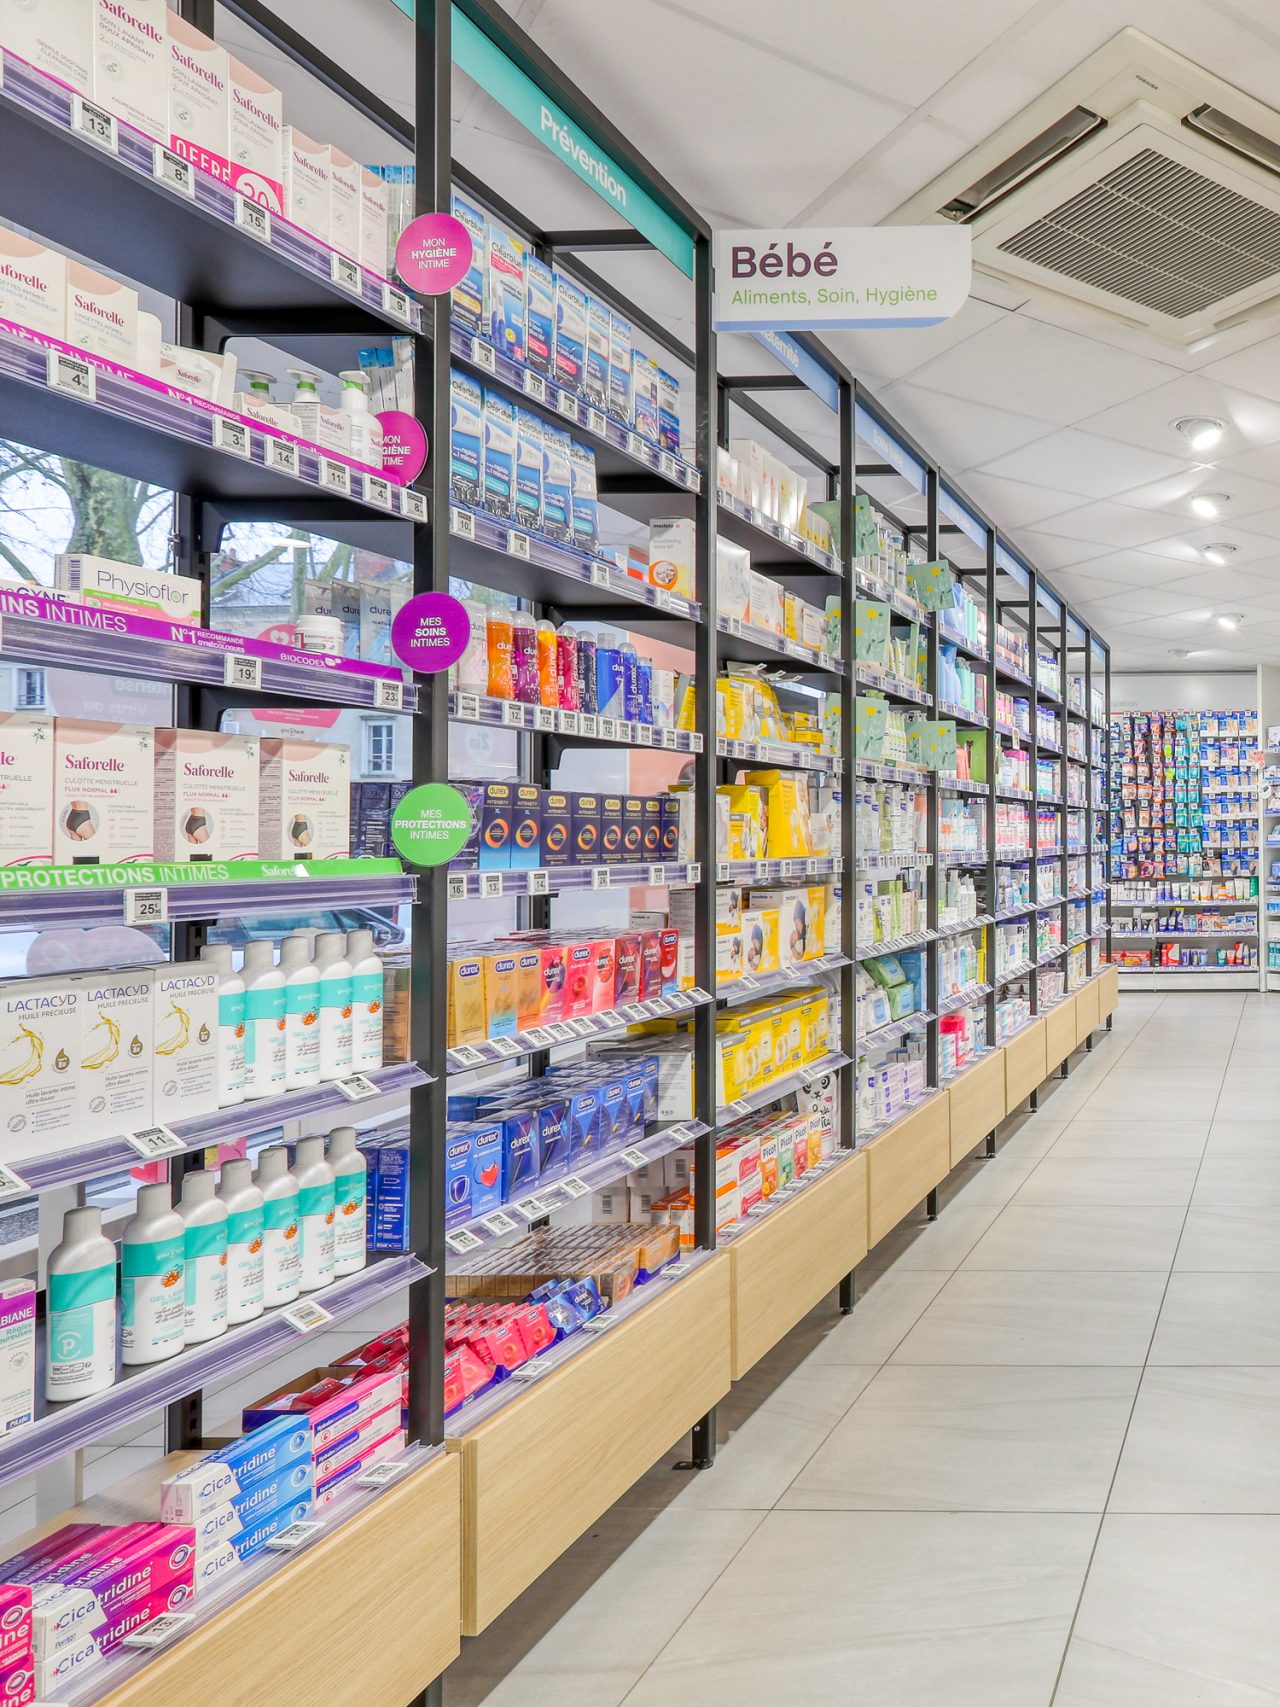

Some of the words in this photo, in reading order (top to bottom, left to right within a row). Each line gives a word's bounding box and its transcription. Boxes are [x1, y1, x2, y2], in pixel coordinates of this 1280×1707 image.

[99, 0, 163, 45] Saforelle
[171, 44, 224, 92] Saforelle
[233, 88, 280, 132] Saforelle
[540, 105, 628, 208] Prévention
[293, 151, 329, 182] Saforelle
[454, 208, 484, 234] Clearblue
[422, 238, 446, 248] MON
[411, 246, 457, 259] HYGIÈNE
[491, 241, 523, 269] Clearblue
[731, 242, 839, 279] Bébé
[418, 259, 450, 269] INTIME
[0, 263, 47, 293] aforelle
[558, 280, 586, 310] Clearblue
[731, 288, 812, 306] Aliments,
[817, 288, 859, 305] Soin,
[866, 286, 938, 306] Hygiène
[74, 294, 125, 327] Saforelle
[761, 332, 800, 368] aternité
[452, 380, 480, 400] Clearblue
[246, 407, 278, 427] Saforelle
[486, 400, 512, 419] Clearblue
[382, 445, 411, 455] GIÈNE
[383, 457, 404, 466] TIME
[97, 570, 189, 604] Physioflor
[0, 595, 39, 618] INS
[45, 603, 127, 633] INTIMES
[420, 617, 442, 626] MES
[415, 628, 447, 637] SOINS
[410, 638, 450, 648] INTIMES
[280, 652, 327, 668] BIOCODEX
[65, 753, 125, 772] Saforelle
[183, 761, 234, 779] Saforelle
[95, 778, 138, 786] MENSTRUELLE
[288, 769, 330, 784] Saforelle
[420, 809, 442, 818] MES
[395, 820, 466, 829] PROTECTIONS
[410, 830, 449, 840] INTIMES
[1, 866, 155, 888] PROTECTIONS
[159, 864, 230, 883] INTIMES
[261, 864, 298, 878] Saforel
[520, 956, 538, 967] durex
[574, 950, 589, 959] durex
[461, 965, 479, 976] durex
[496, 960, 514, 971] durex
[160, 975, 215, 992] LACTACYD
[87, 984, 149, 1002] LACTACYD
[169, 991, 186, 999] HUILE
[7, 993, 77, 1013] LACTACYD
[97, 1001, 117, 1010] HUILE
[18, 1012, 40, 1021] HUILE
[25, 1090, 41, 1100] Huile
[60, 1085, 76, 1093] intime
[579, 1098, 594, 1109] durex
[477, 1131, 497, 1146] durex
[542, 1124, 562, 1137] durex
[795, 1125, 807, 1140] Picot
[510, 1135, 530, 1150] durex
[779, 1134, 793, 1149] Picot
[449, 1143, 470, 1157] durex
[763, 1144, 777, 1160] Picot
[7, 1285, 33, 1296] NOUVEAU
[1, 1308, 33, 1326] BIANE
[0, 1328, 32, 1344] oureuses
[201, 1446, 276, 1498] Cicatridine
[204, 1481, 278, 1536] Cicatridine
[205, 1519, 278, 1576] Cicatridine
[59, 1564, 152, 1630] Cicatridine
[58, 1607, 151, 1674] Cicatridine
